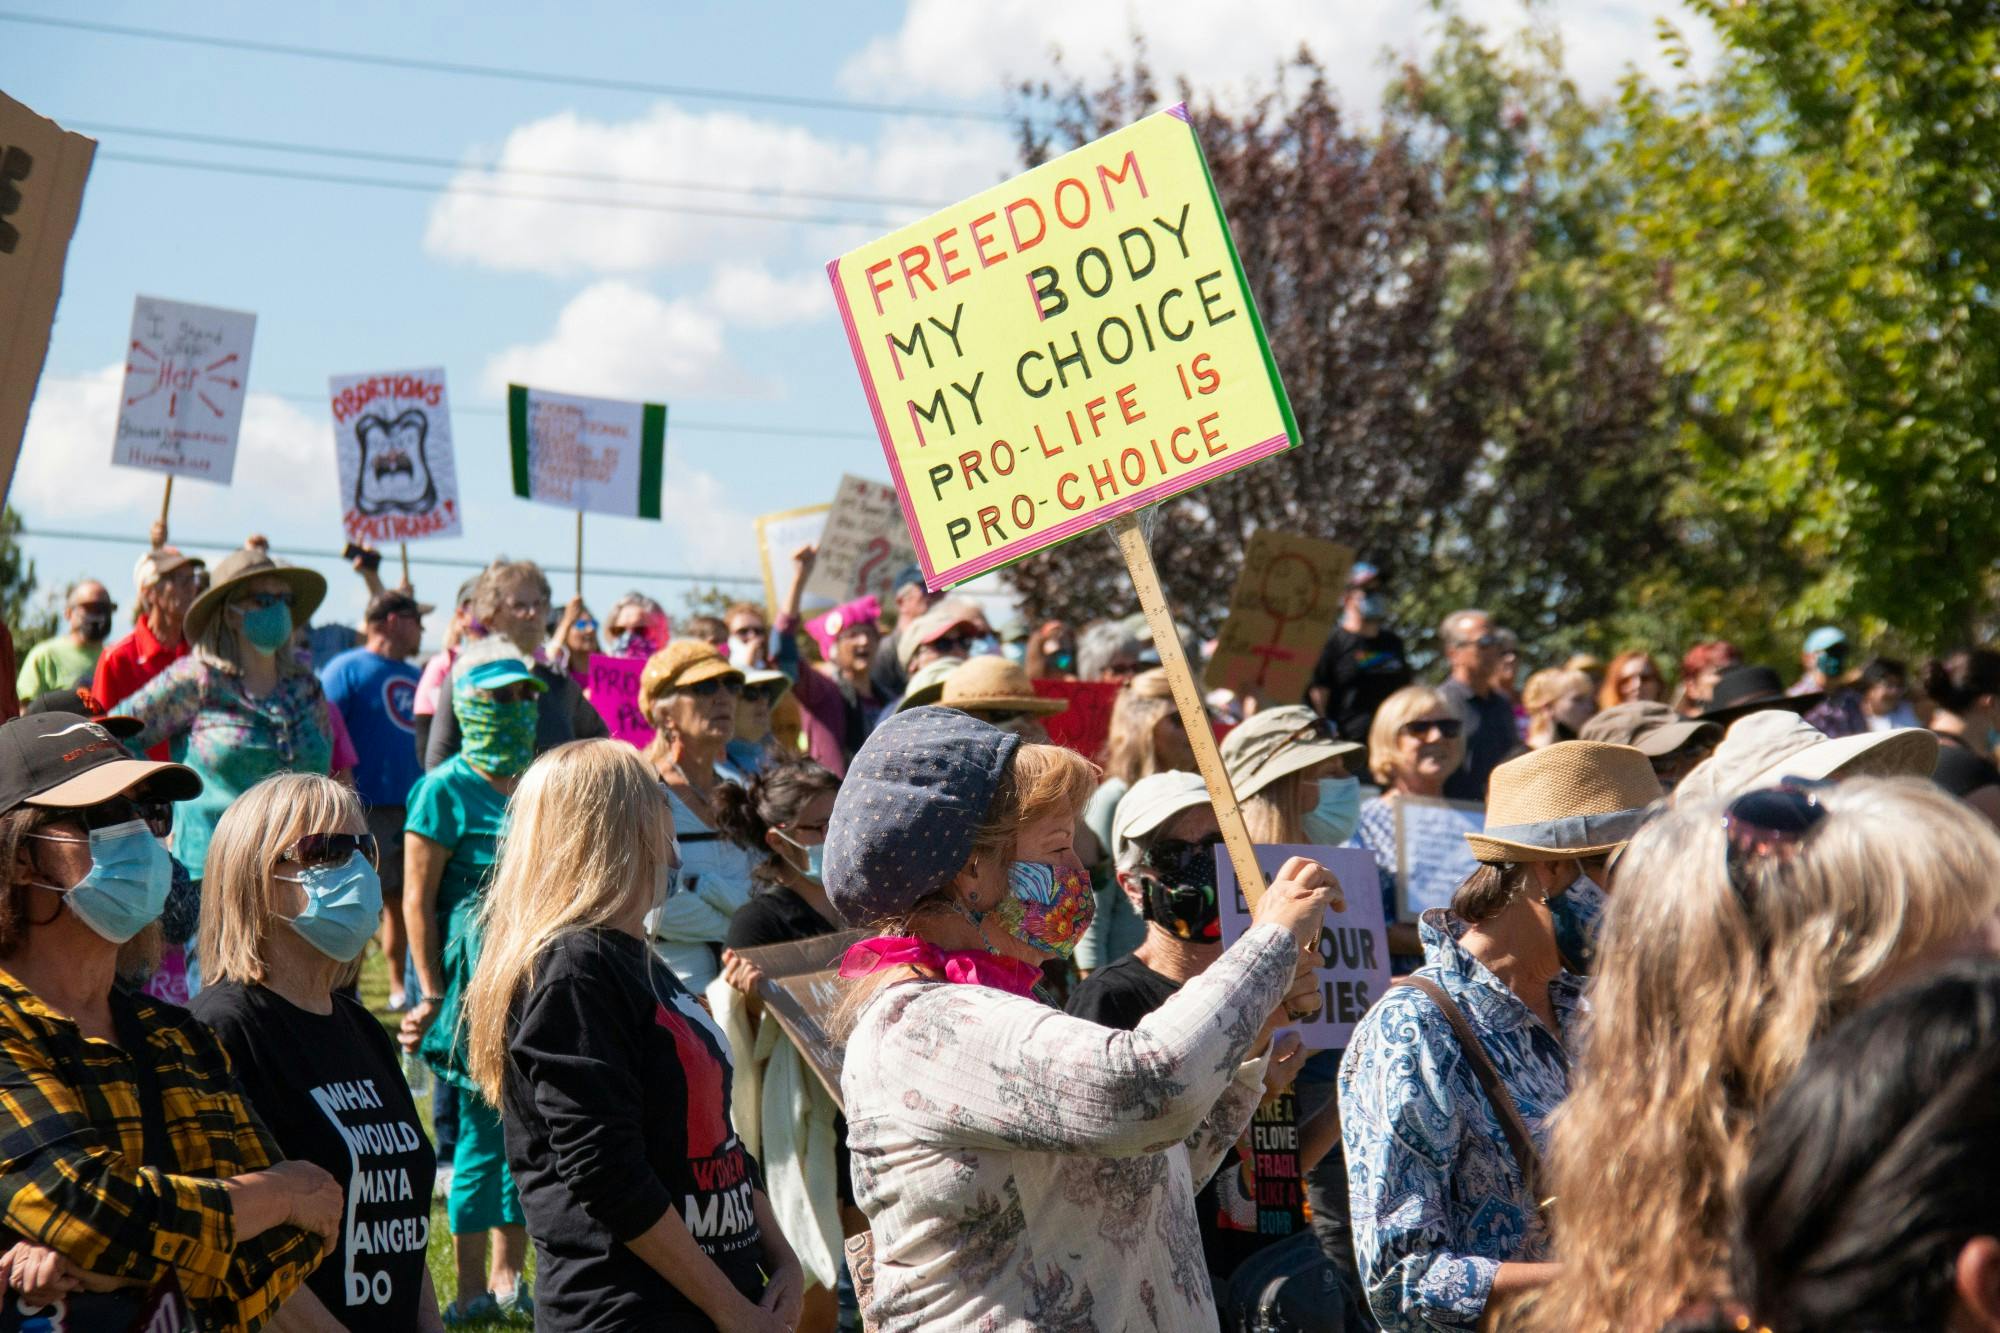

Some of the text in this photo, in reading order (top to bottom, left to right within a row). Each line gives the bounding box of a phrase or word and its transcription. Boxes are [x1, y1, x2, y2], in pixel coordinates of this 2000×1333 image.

[865, 150, 1149, 316] FREEDOM
[885, 203, 1191, 381] MY BODY
[158, 358, 200, 392] Her
[906, 269, 1237, 448] MY CHOICE
[332, 374, 443, 425] ABORTIONS
[928, 352, 1221, 501] PRO-LIFE IS
[946, 411, 1229, 559] PRO-CHOICE
[322, 1079, 383, 1112] WHAT
[1255, 1099, 1294, 1122] LIKE A
[347, 1121, 420, 1156] WOULD
[1254, 1126, 1299, 1150] FLOWE
[356, 1168, 413, 1204] MAYA
[1258, 1180, 1298, 1206] LIKE A
[1260, 1209, 1292, 1235] BOMB
[346, 1269, 392, 1306] DO
